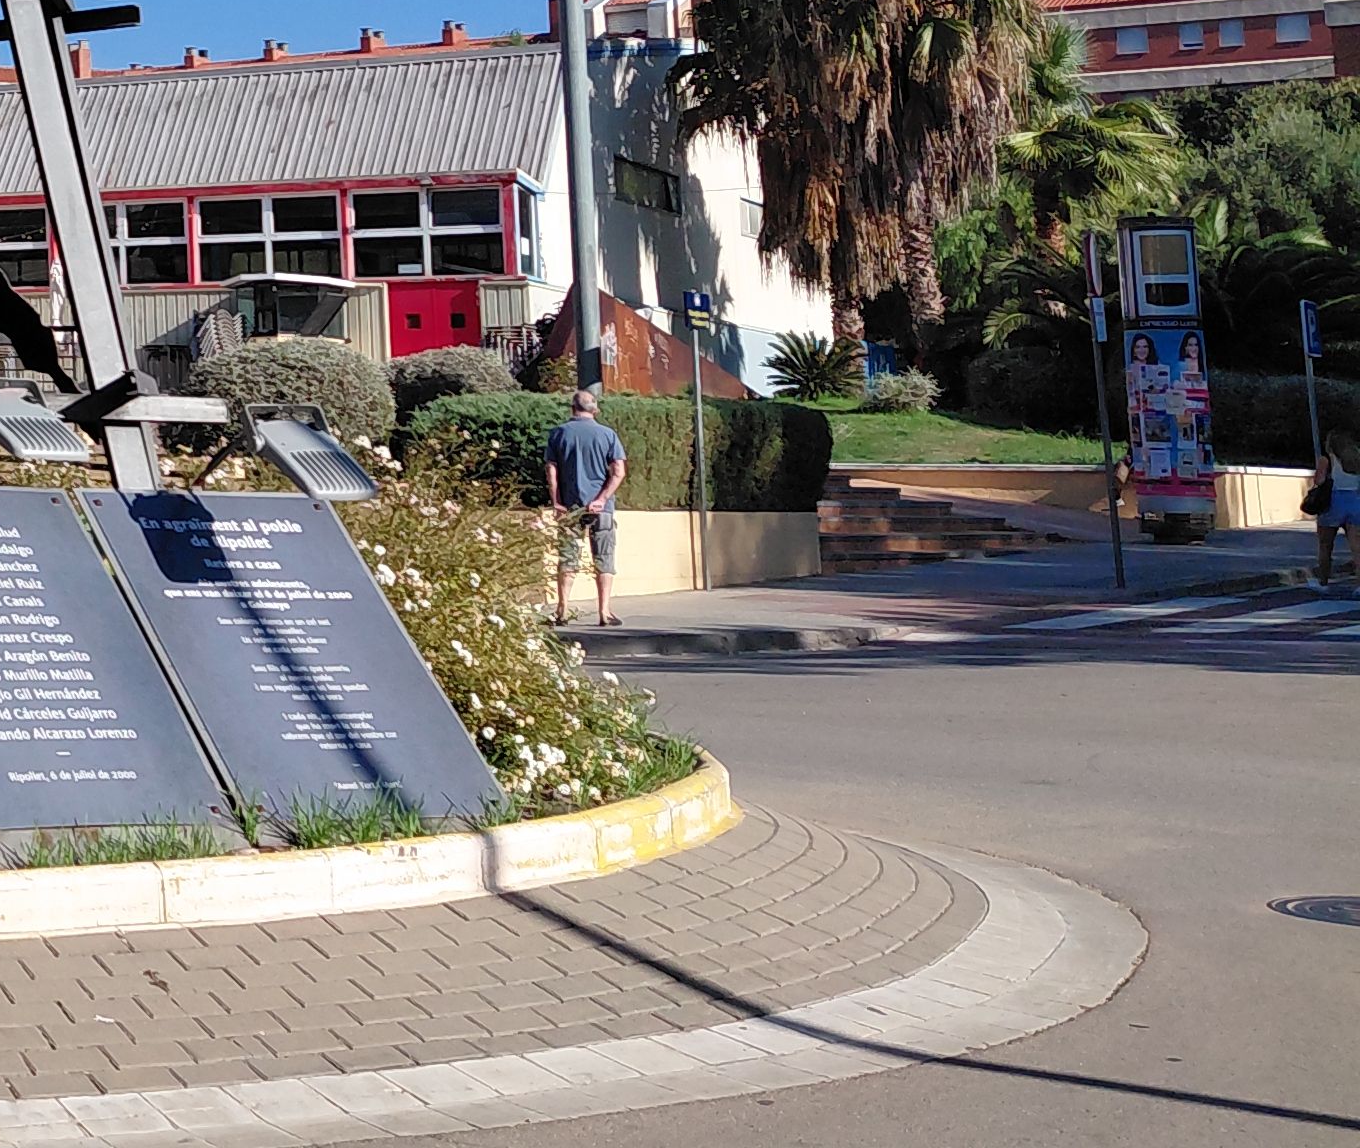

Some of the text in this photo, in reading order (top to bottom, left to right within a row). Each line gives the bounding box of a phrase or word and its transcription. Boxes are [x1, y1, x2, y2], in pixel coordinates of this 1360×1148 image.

[138, 516, 161, 530] En
[242, 518, 258, 532] al
[259, 519, 303, 536] poble
[190, 534, 209, 548] de
[16, 578, 46, 590] Ruiz
[3, 595, 45, 607] Canals
[11, 613, 60, 627] Rodrigo
[31, 631, 74, 646] Crespo
[4, 649, 48, 664] Aragón
[48, 650, 91, 662] Benito
[2, 668, 48, 681] Murillo
[49, 668, 94, 681] Matilla
[13, 688, 32, 701] Gil
[33, 687, 102, 701] Hernández
[13, 707, 67, 720] Cárceles
[66, 706, 118, 722] Guijarro
[33, 727, 87, 740] Alcarazo
[86, 727, 138, 740] Lorenzo
[59, 770, 72, 780] de
